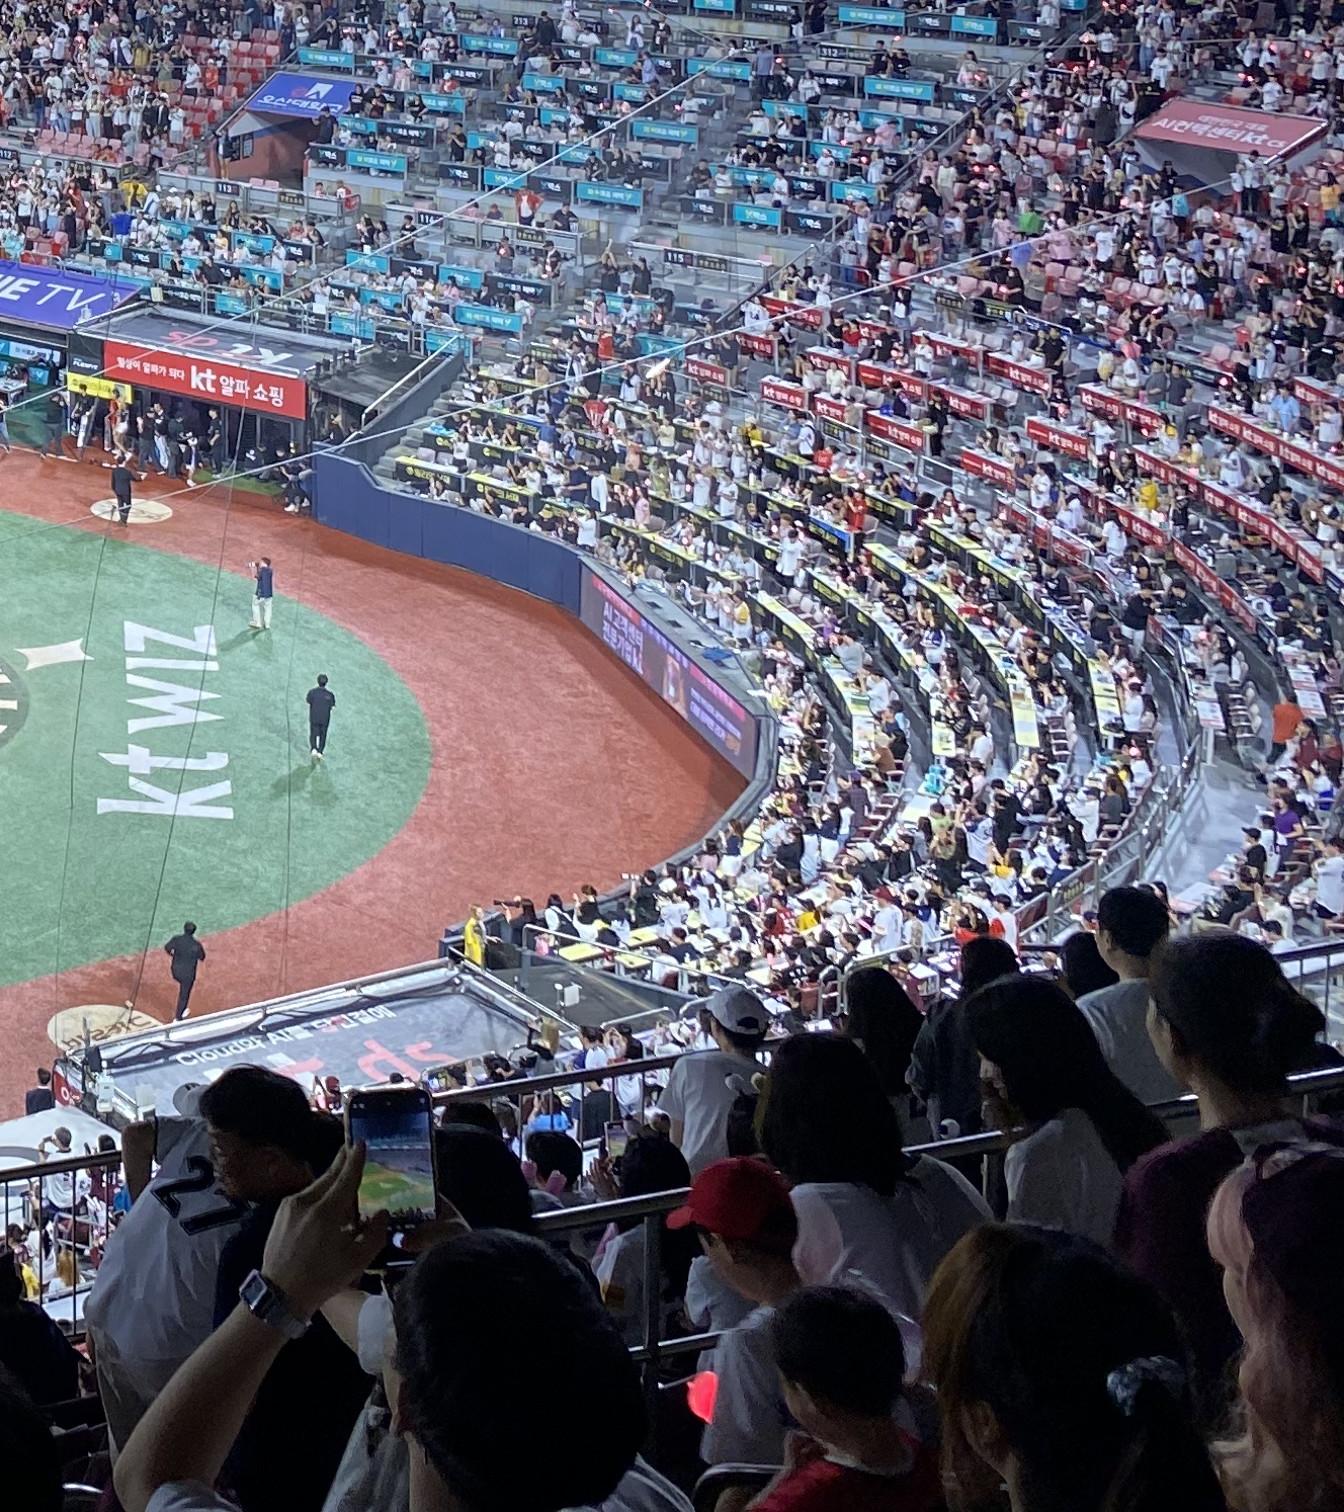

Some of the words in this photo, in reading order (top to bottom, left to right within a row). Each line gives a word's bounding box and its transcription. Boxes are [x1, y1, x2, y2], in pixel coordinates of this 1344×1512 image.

[821, 48, 838, 58] 312
[0, 149, 12, 160] 112
[667, 251, 684, 262] 115
[34, 283, 105, 313] TV
[688, 362, 698, 375] kt
[1009, 367, 1020, 382] kt
[169, 368, 185, 381] 되다
[191, 365, 216, 394] kt
[219, 374, 250, 400] 알파
[253, 385, 284, 408] 쇼핑
[764, 383, 775, 398] kt
[816, 398, 828, 412] kt
[1082, 391, 1094, 406] kt
[888, 423, 899, 438] kt
[1048, 431, 1061, 448] kt
[982, 462, 993, 476] kt
[97, 743, 234, 820] kt
[175, 1036, 265, 1066] Cloud와
